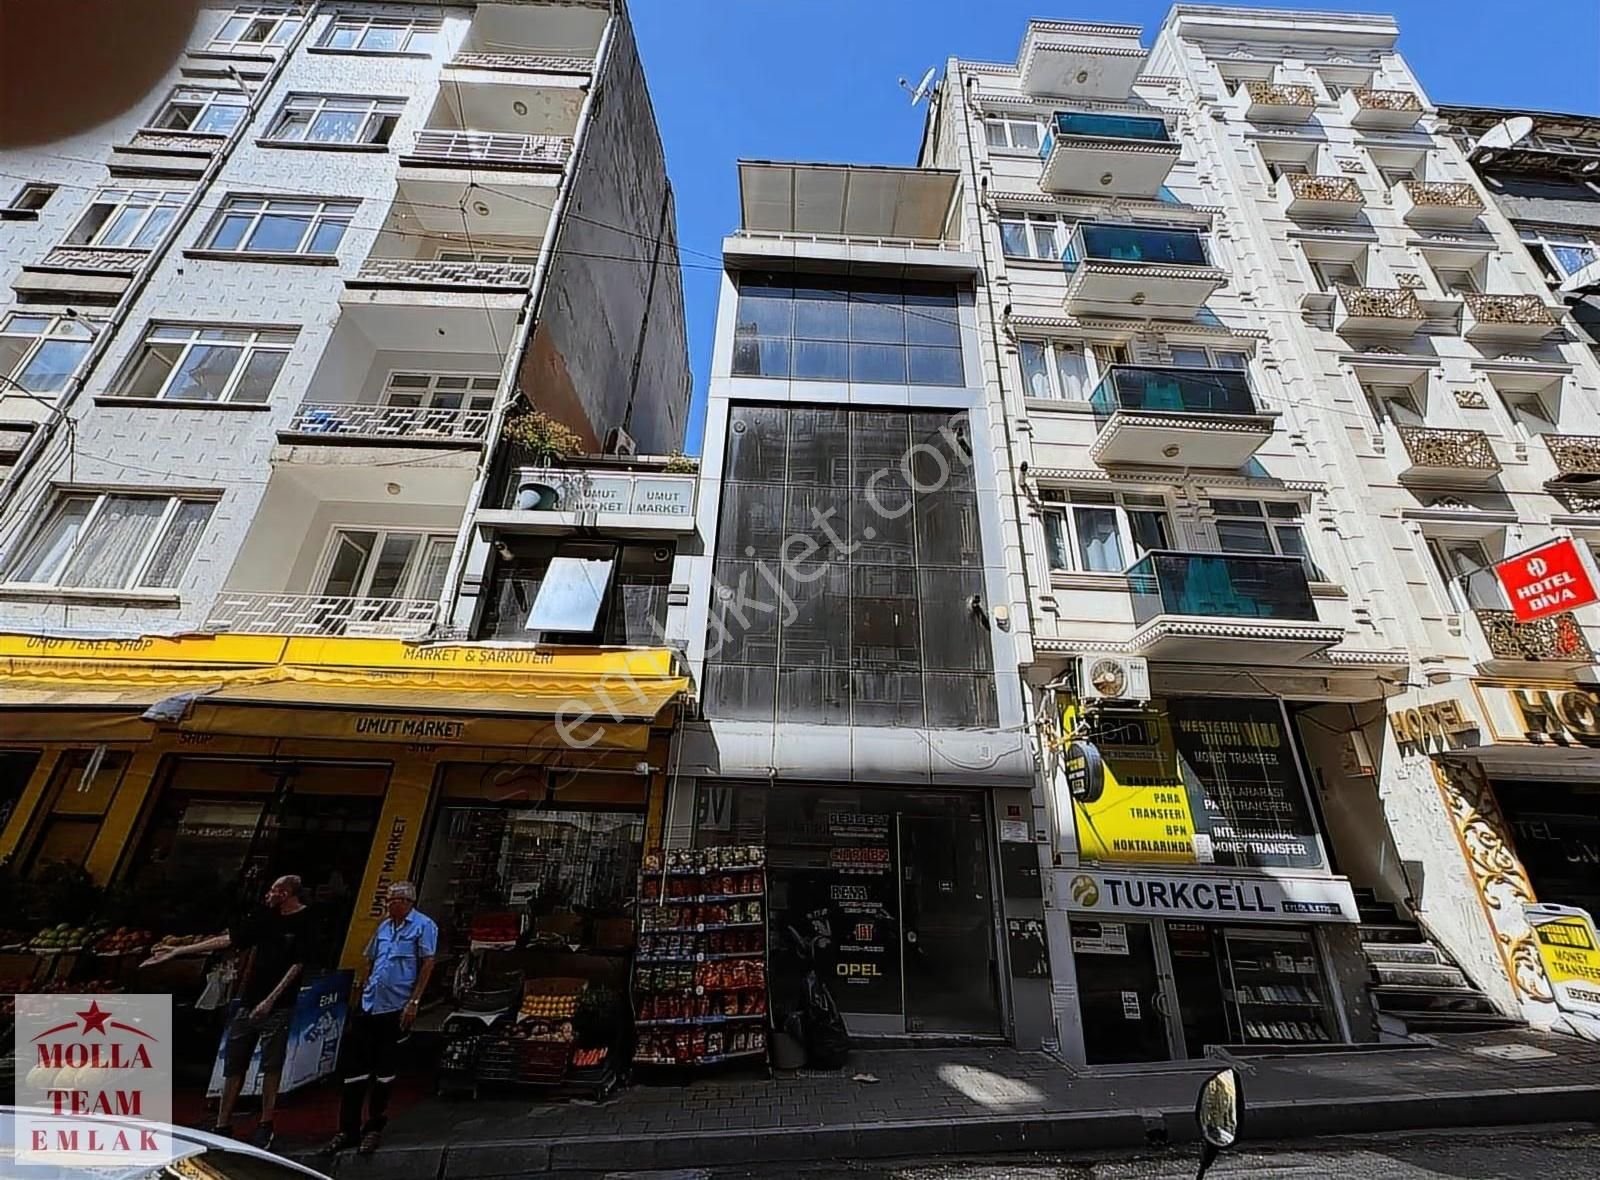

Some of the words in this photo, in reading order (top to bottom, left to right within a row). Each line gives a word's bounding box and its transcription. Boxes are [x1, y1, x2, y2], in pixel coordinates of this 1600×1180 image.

[647, 491, 680, 501] UMUT
[637, 504, 687, 513] MARKET
[1516, 571, 1577, 599] HOTEL
[1529, 588, 1577, 612] DİVA
[403, 647, 459, 662] MARKET
[465, 651, 476, 663] &
[356, 717, 400, 734] UMUT
[402, 719, 464, 738] MARKET
[1180, 720, 1238, 734] WESTERN
[1389, 698, 1477, 746] HOTEL
[1202, 733, 1243, 746] UNION
[1194, 752, 1226, 764] MONEY
[1153, 793, 1180, 804] PARA
[1165, 825, 1187, 836] BPN
[1213, 826, 1297, 840] INTERNATIONAL
[382, 816, 407, 872] MARKET
[1212, 841, 1248, 853] MONEY
[1249, 842, 1307, 856] TRANSFER
[1103, 879, 1276, 913] TURKCELL
[1554, 949, 1588, 964] MONEY
[836, 962, 882, 976] OPEL
[1552, 962, 1600, 978] TRANSFE
